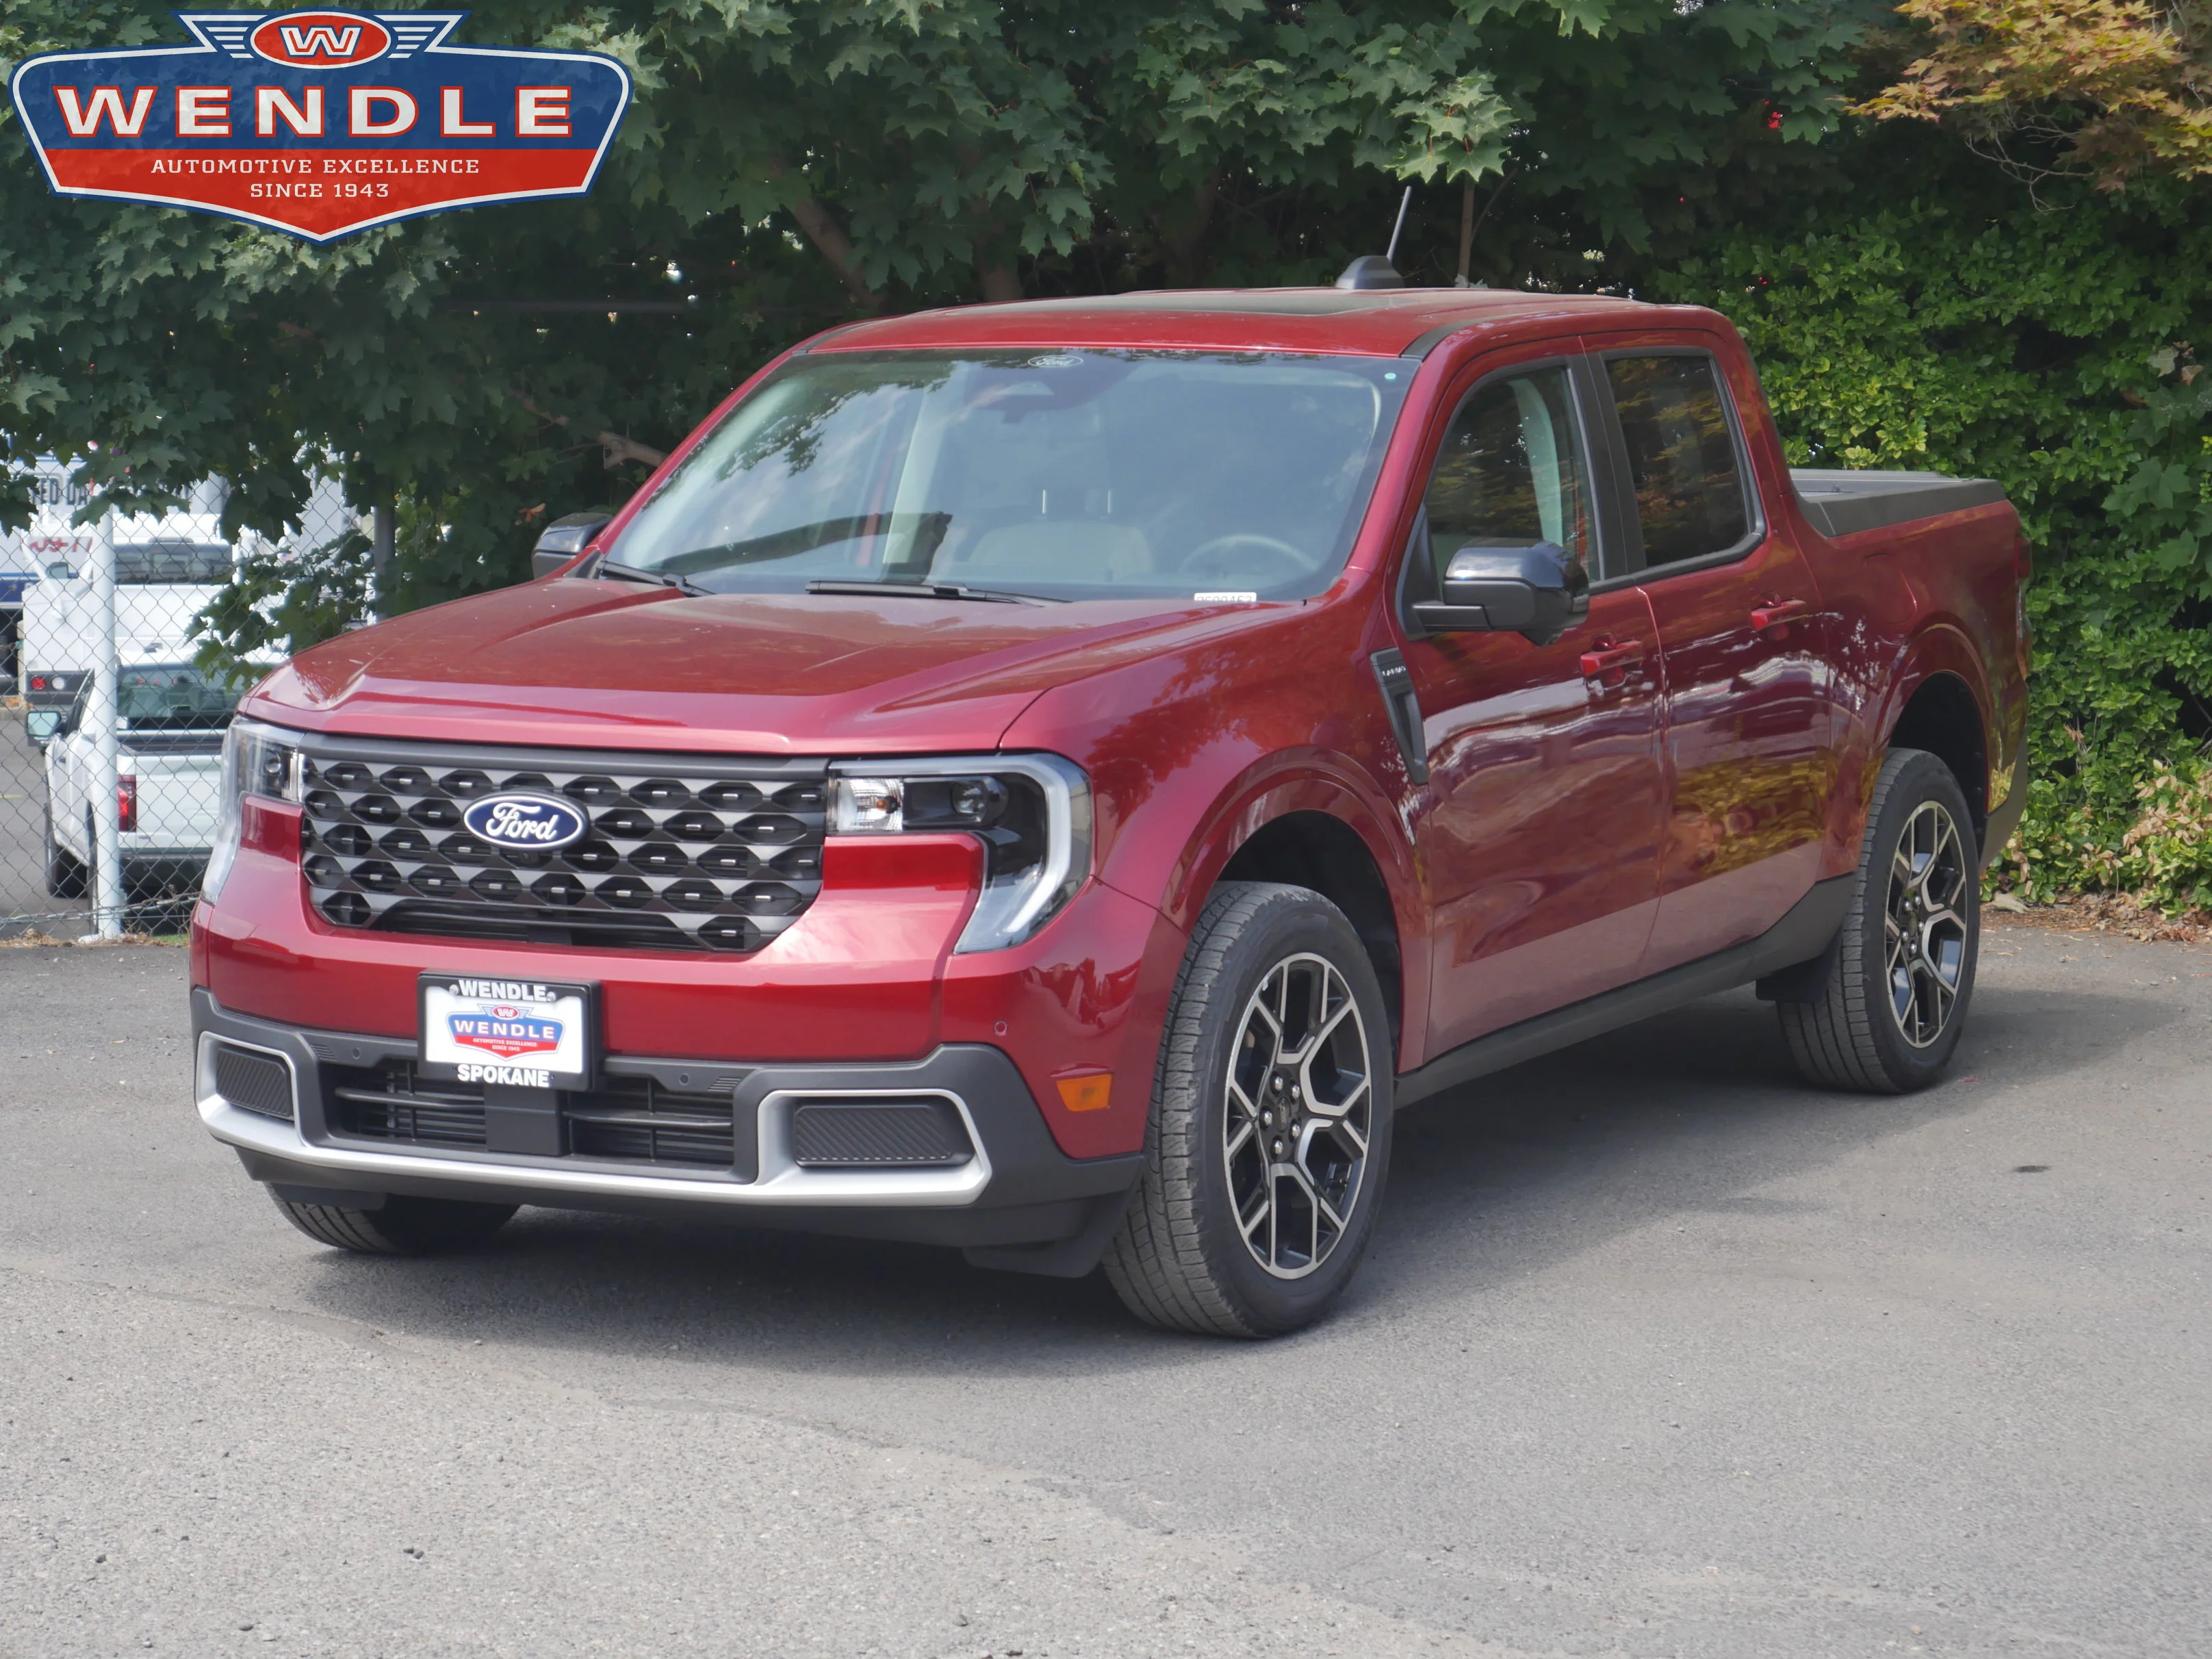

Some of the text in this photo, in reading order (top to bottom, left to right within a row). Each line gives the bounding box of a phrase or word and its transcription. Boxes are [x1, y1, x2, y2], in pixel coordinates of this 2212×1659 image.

[486, 802, 558, 840] Ford
[459, 979, 548, 1002] WENDLE
[454, 1019, 554, 1039] WENDLE
[457, 1064, 550, 1088] SPOKANE
